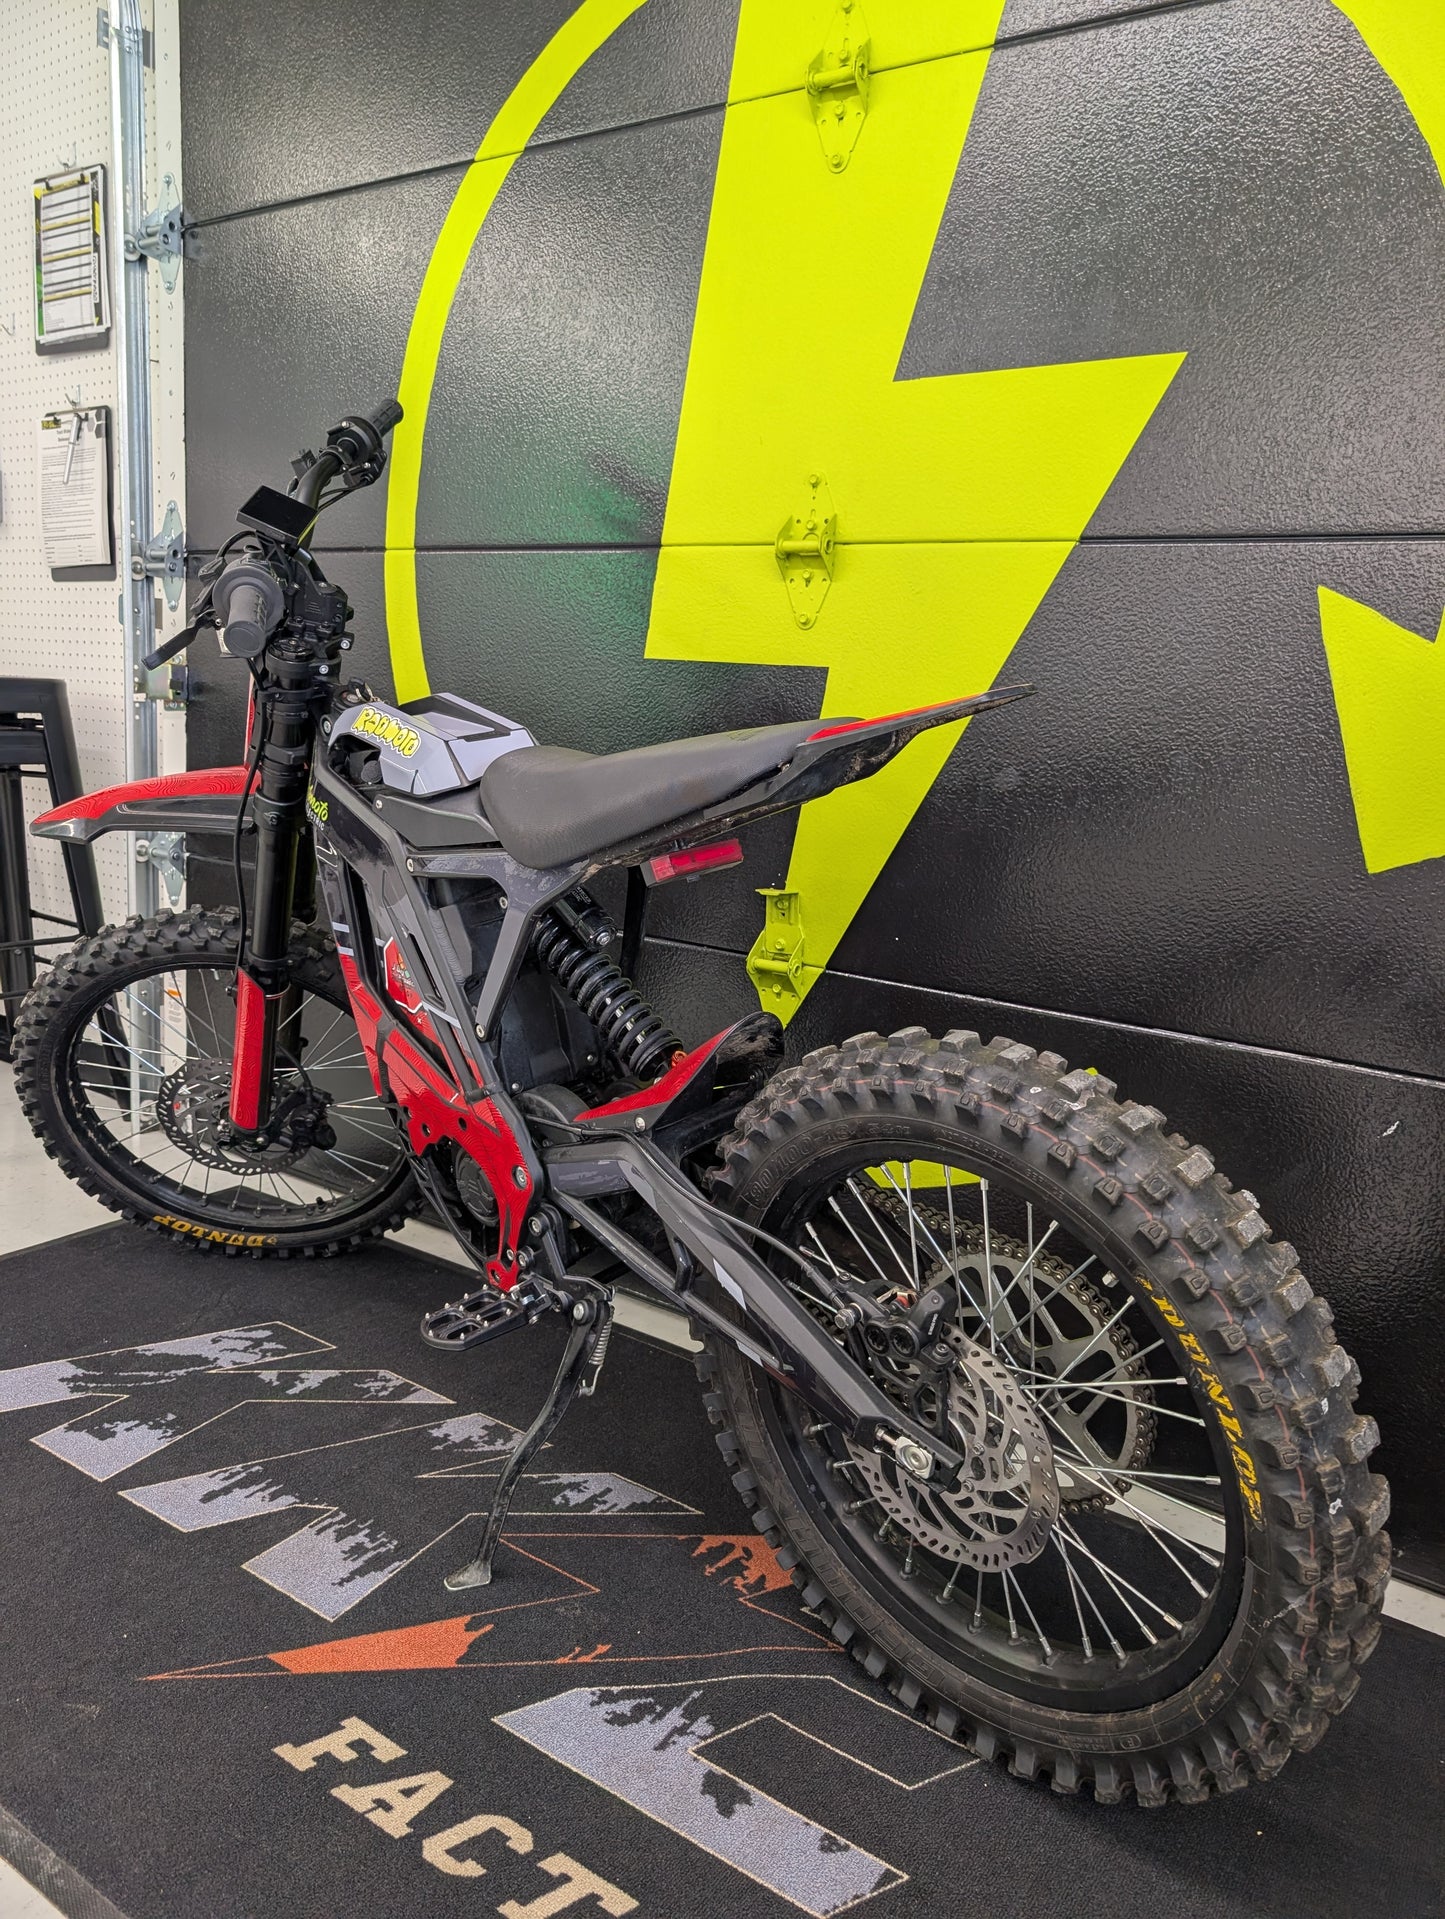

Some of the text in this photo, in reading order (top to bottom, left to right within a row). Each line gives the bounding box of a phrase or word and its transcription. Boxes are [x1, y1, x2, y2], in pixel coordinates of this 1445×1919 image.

[352, 707, 421, 758] RADMOTO
[153, 1215, 267, 1247] DUNLOP
[1151, 1294, 1266, 1531] DUNLOP
[271, 1716, 640, 1919] FACT
